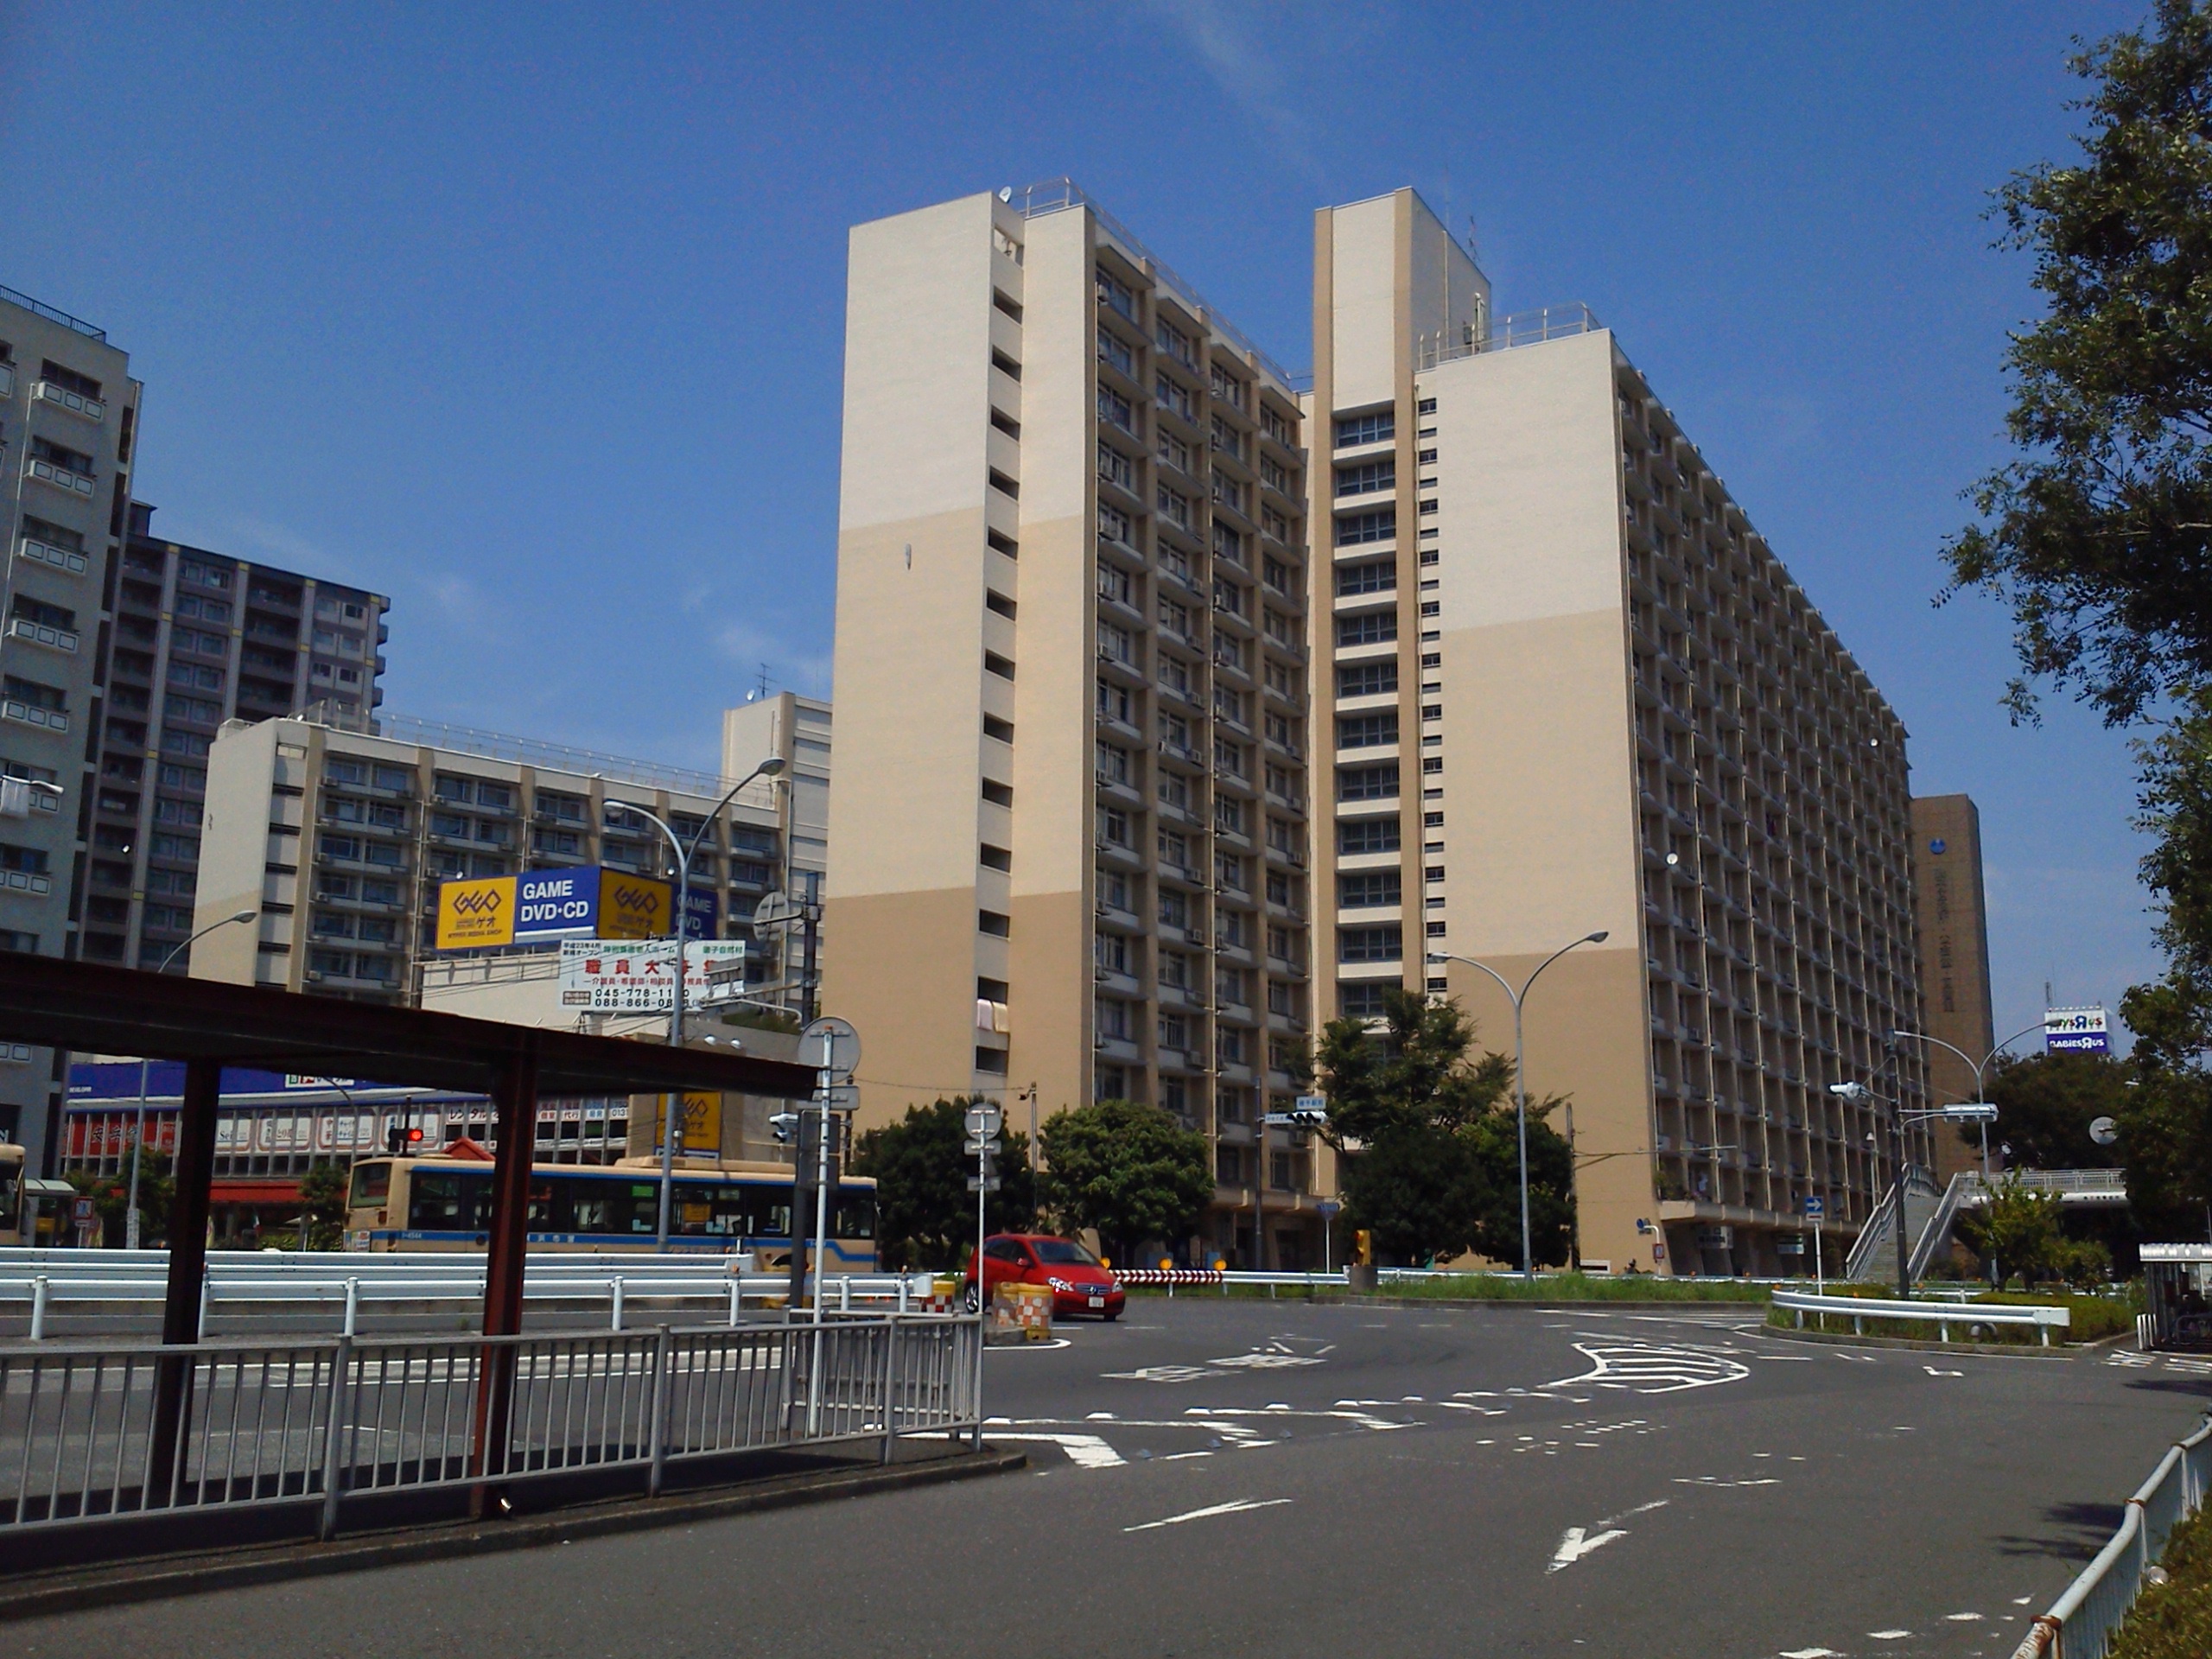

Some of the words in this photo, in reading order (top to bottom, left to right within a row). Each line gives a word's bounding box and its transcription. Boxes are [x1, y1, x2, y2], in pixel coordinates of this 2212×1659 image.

[523, 880, 573, 900] GAME
[453, 889, 502, 915] GEO
[595, 988, 690, 997] 045-778-110
